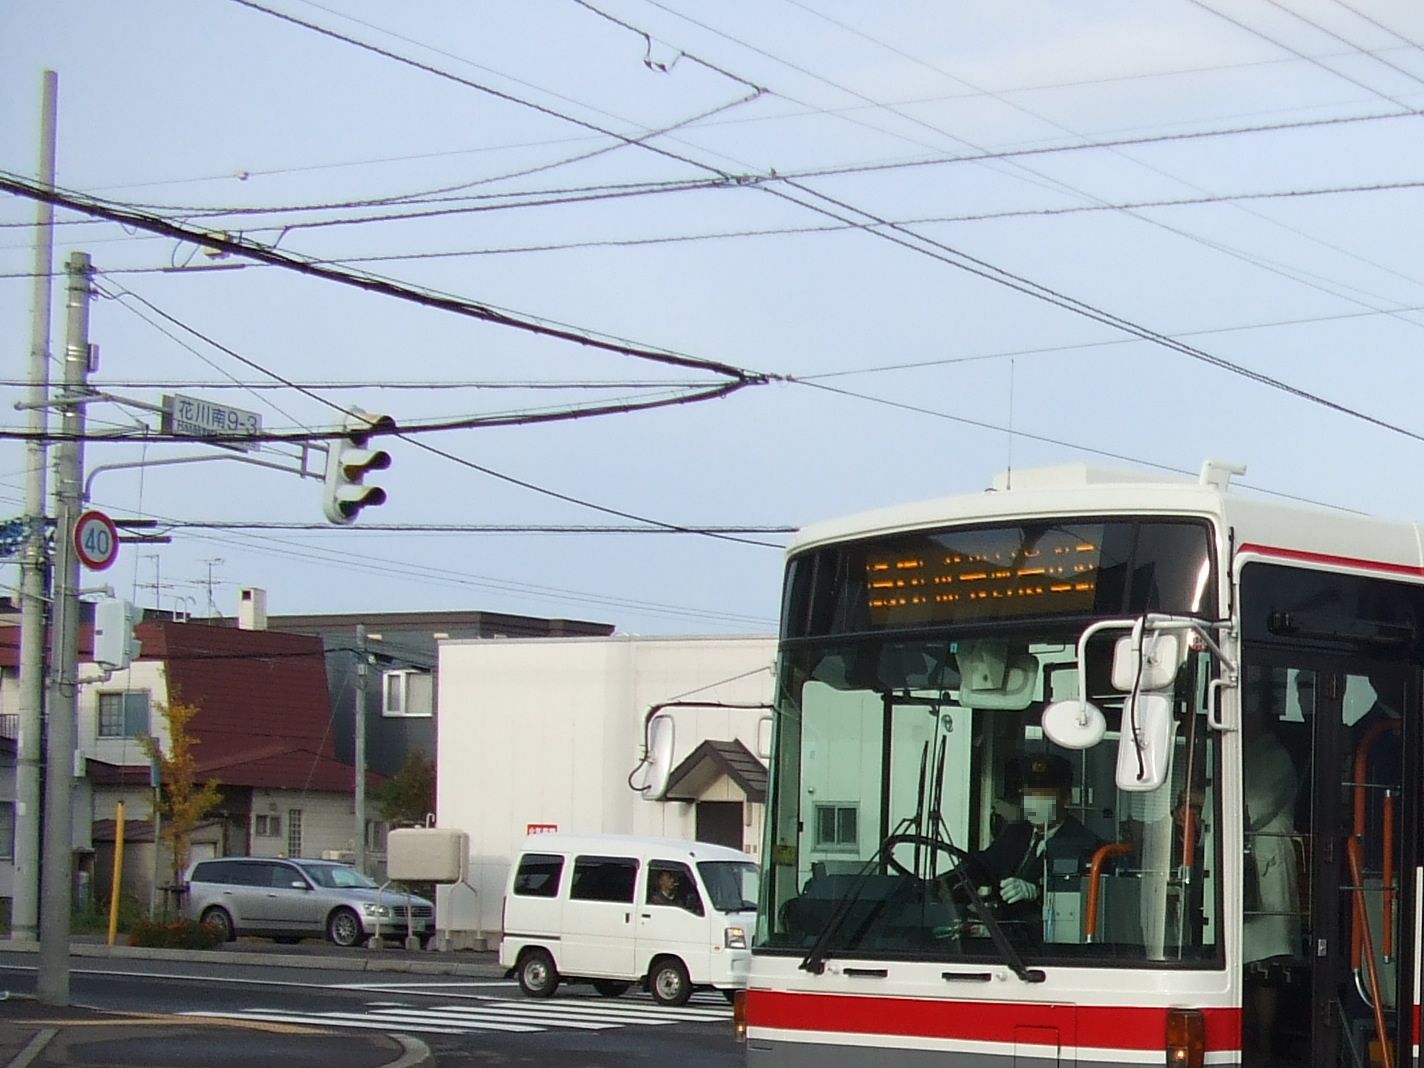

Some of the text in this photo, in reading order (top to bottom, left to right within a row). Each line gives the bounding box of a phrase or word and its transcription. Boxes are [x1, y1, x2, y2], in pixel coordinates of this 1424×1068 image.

[179, 400, 257, 436] 花川南9-3
[84, 527, 109, 555] 40
